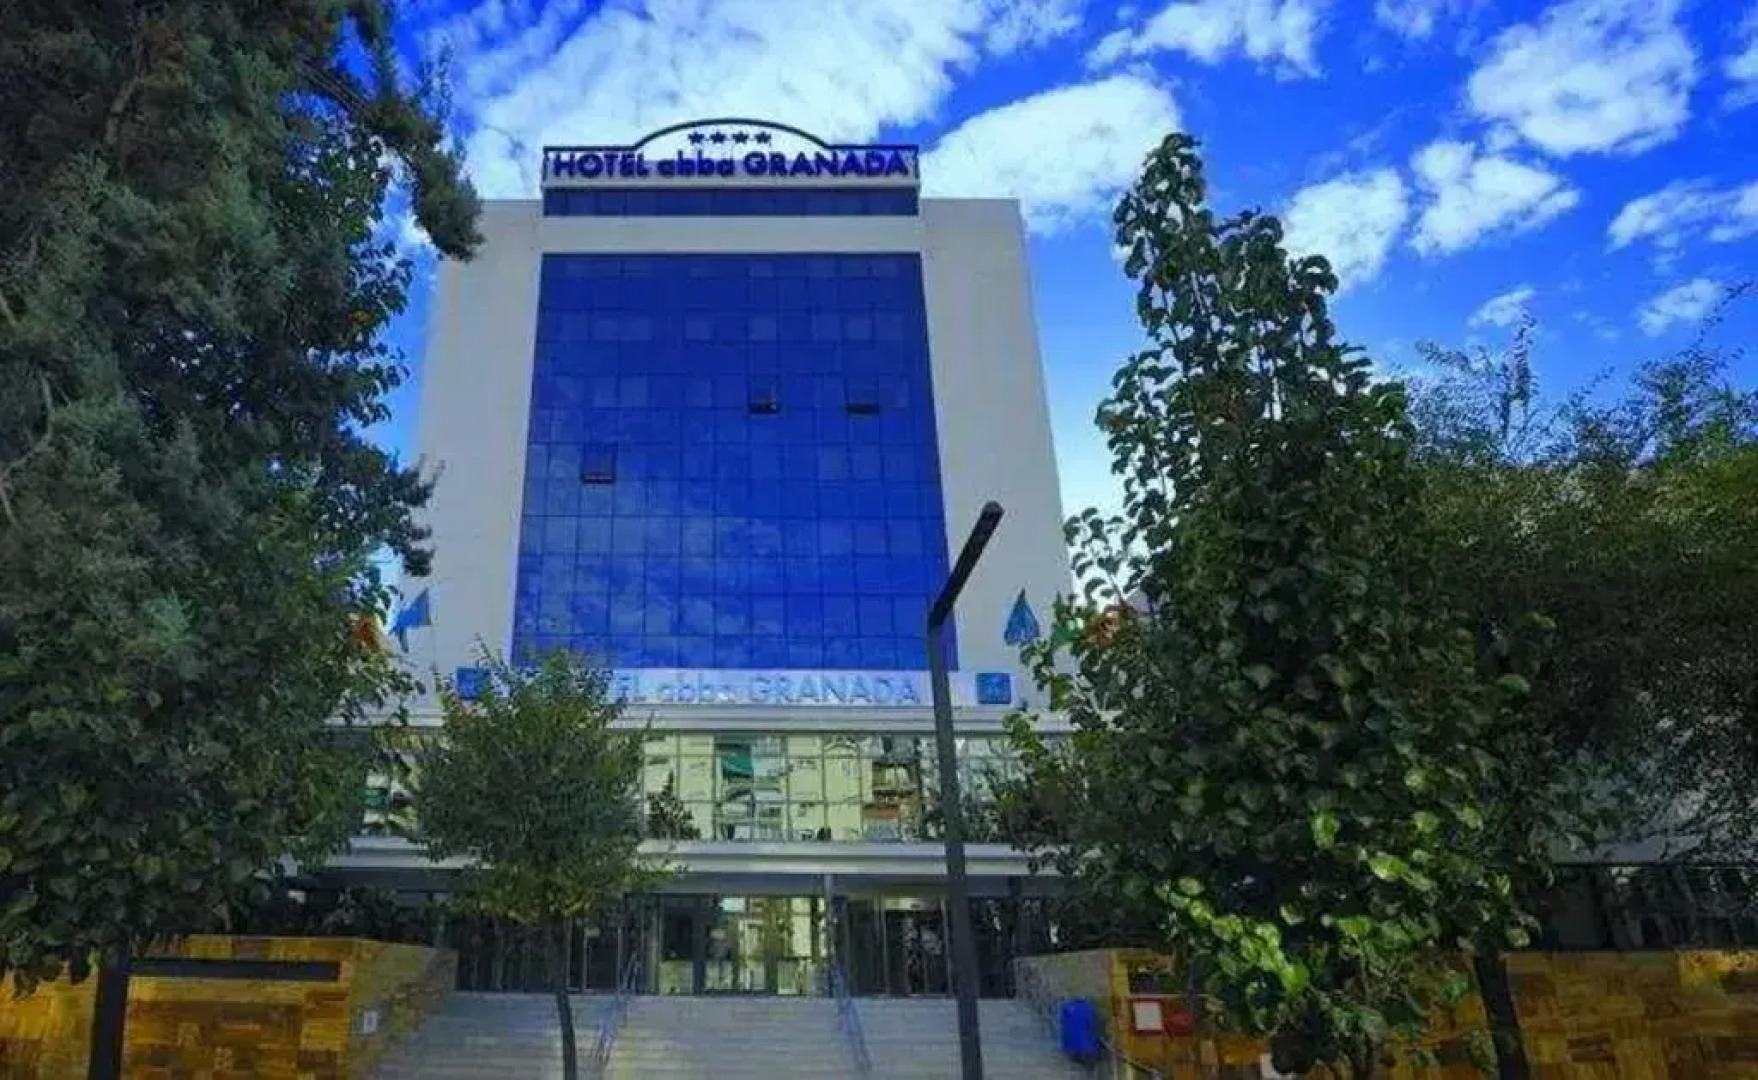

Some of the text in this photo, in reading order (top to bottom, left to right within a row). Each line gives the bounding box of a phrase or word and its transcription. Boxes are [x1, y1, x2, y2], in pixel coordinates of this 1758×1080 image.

[554, 150, 908, 178] HOTEL abba GRANADA
[752, 673, 920, 703] GRANADA
